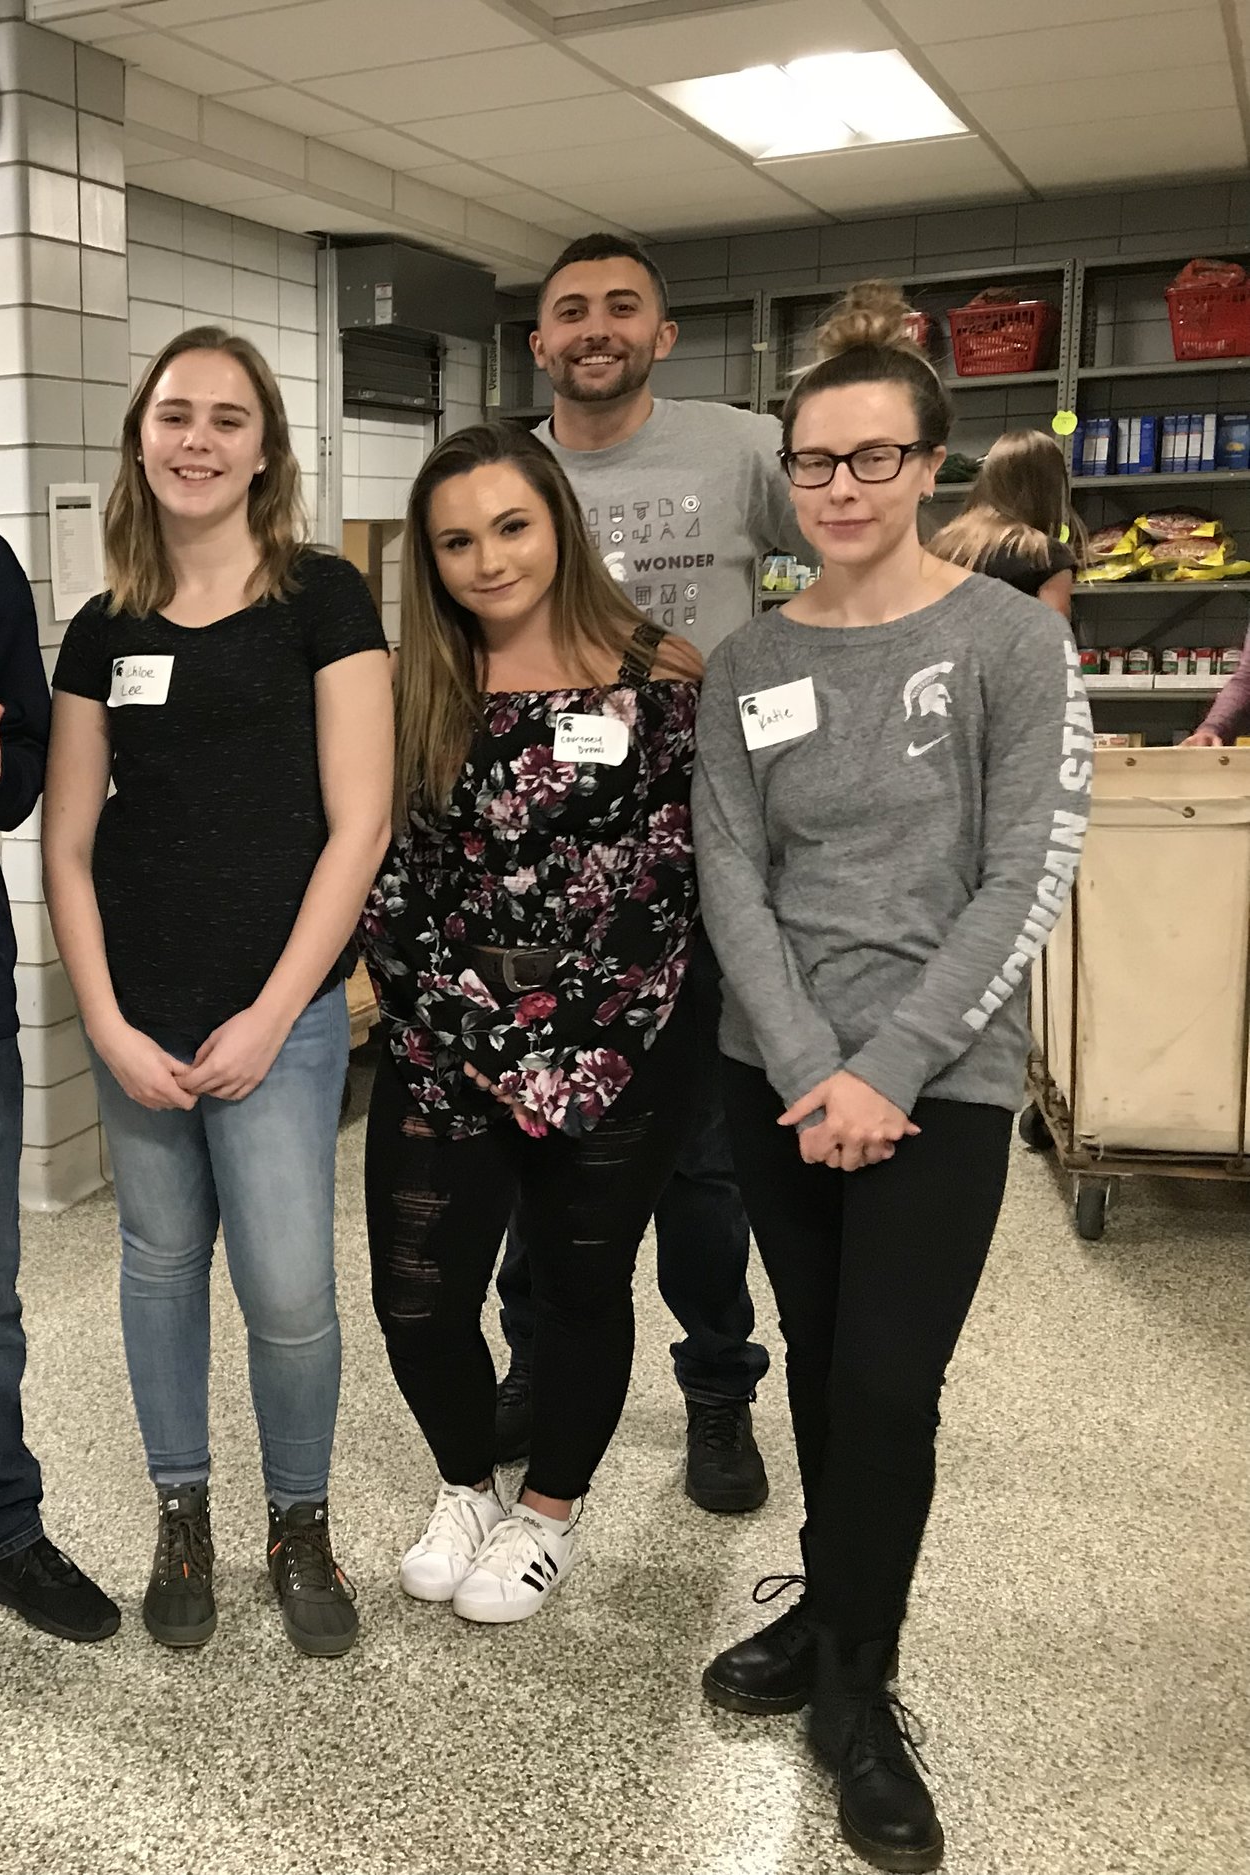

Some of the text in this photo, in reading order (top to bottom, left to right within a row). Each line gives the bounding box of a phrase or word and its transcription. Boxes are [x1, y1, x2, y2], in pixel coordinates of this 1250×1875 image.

[633, 553, 715, 573] WONDER
[125, 665, 155, 678] Chloe
[121, 685, 144, 697] Lee
